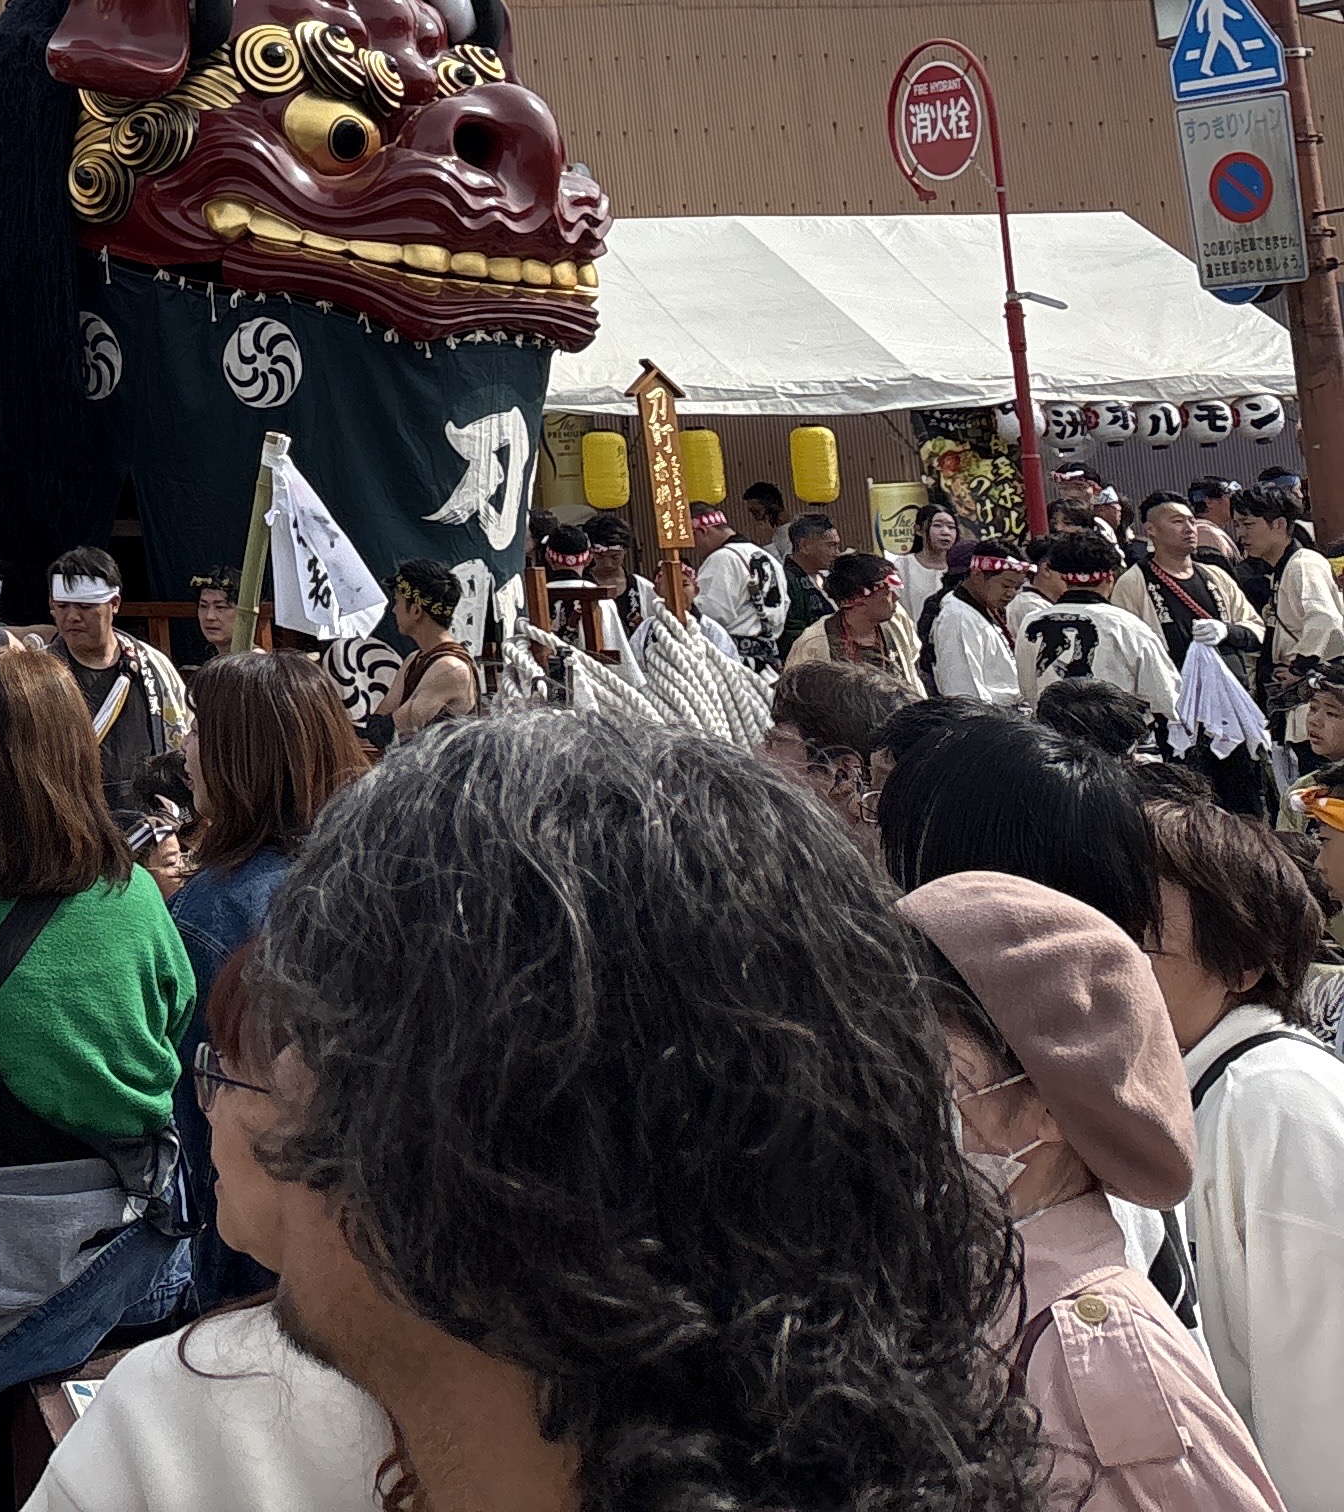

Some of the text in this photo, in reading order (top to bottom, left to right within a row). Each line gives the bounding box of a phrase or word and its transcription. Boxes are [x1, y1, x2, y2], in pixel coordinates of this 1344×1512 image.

[913, 77, 962, 97] FIRE HYDRANT
[908, 95, 972, 145] 消火栓
[1001, 401, 1281, 440] 洲ホルモン
